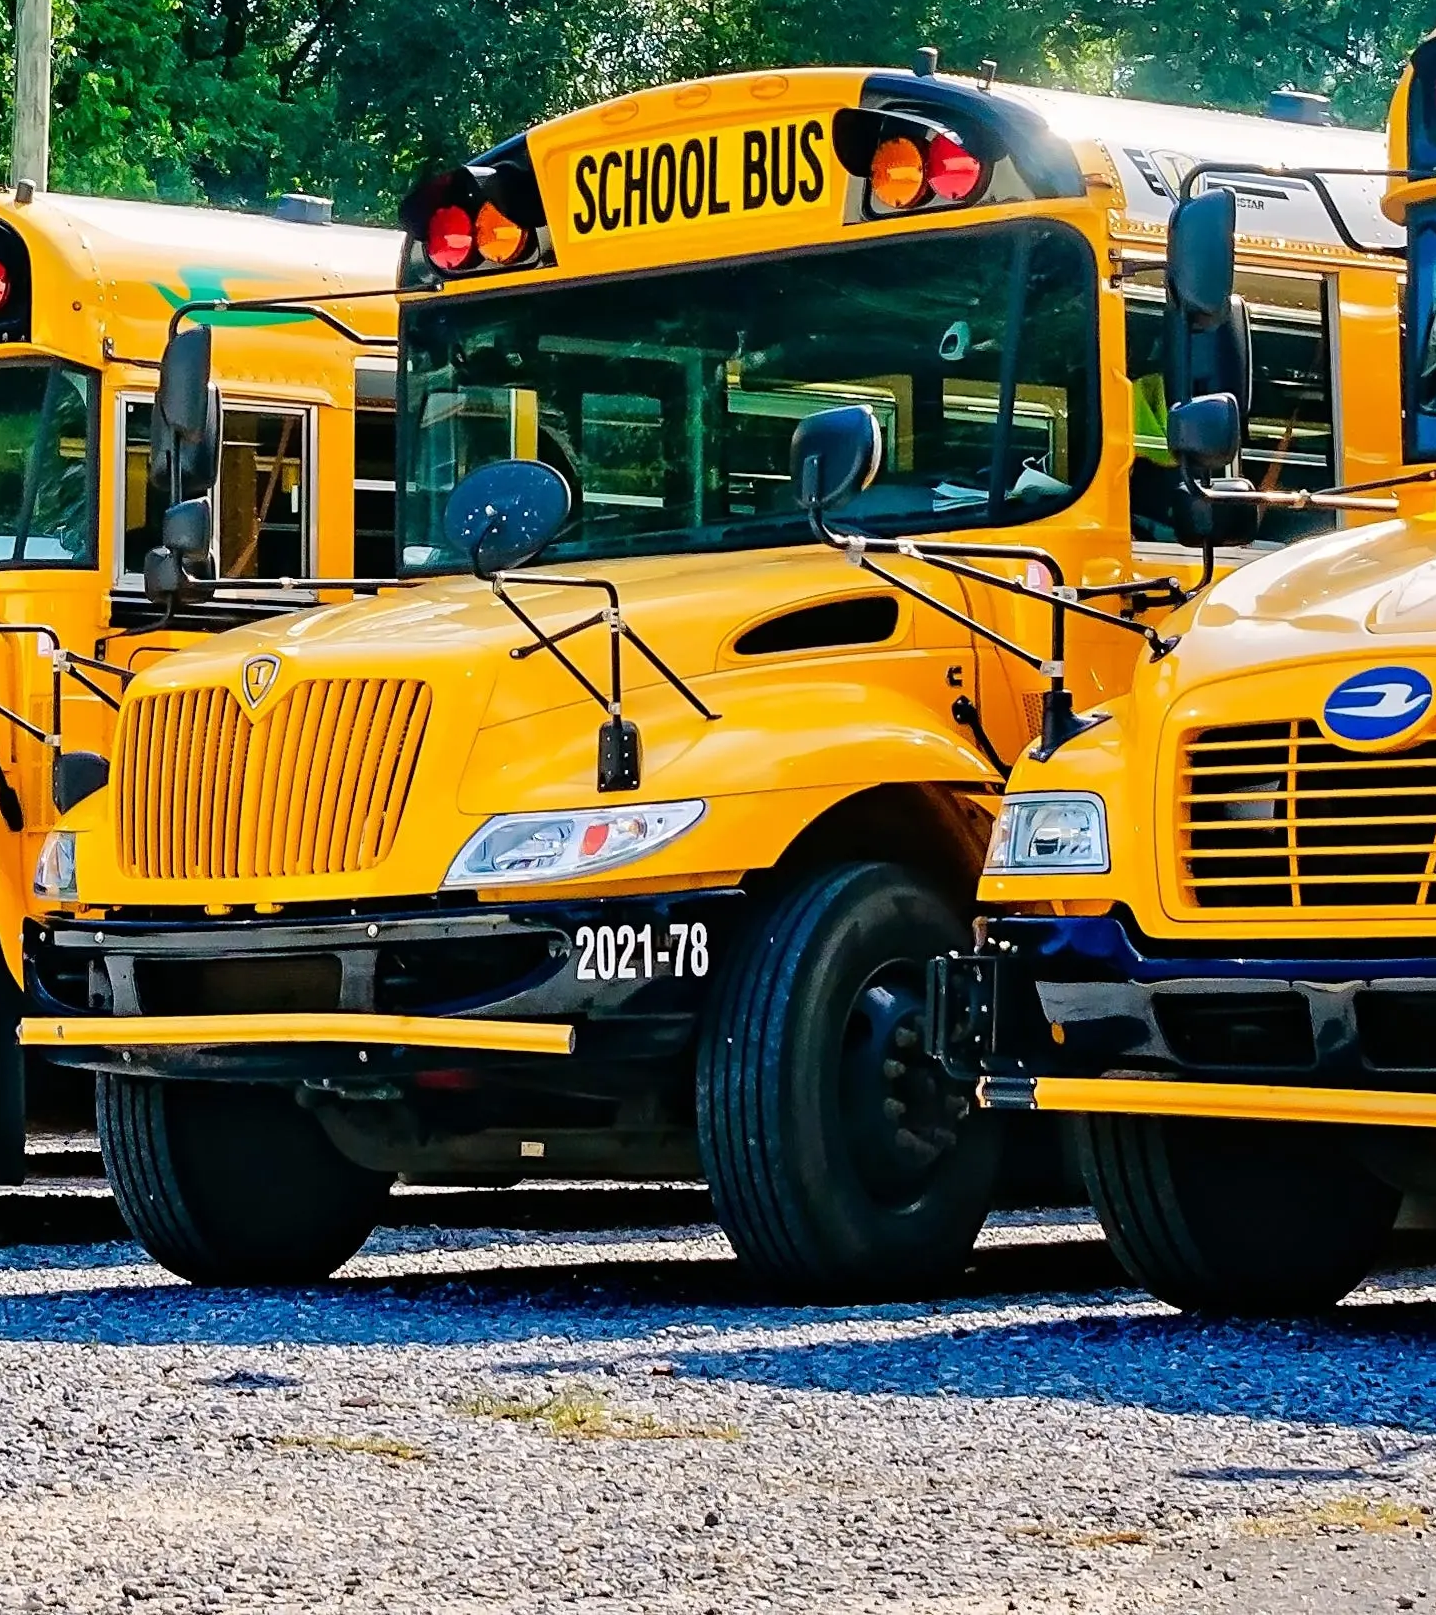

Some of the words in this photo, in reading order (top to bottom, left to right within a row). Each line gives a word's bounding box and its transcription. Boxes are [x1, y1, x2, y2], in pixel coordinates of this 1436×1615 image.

[573, 136, 731, 235] SCHOOL
[743, 119, 825, 211] BUS
[575, 922, 709, 981] 2021-78
